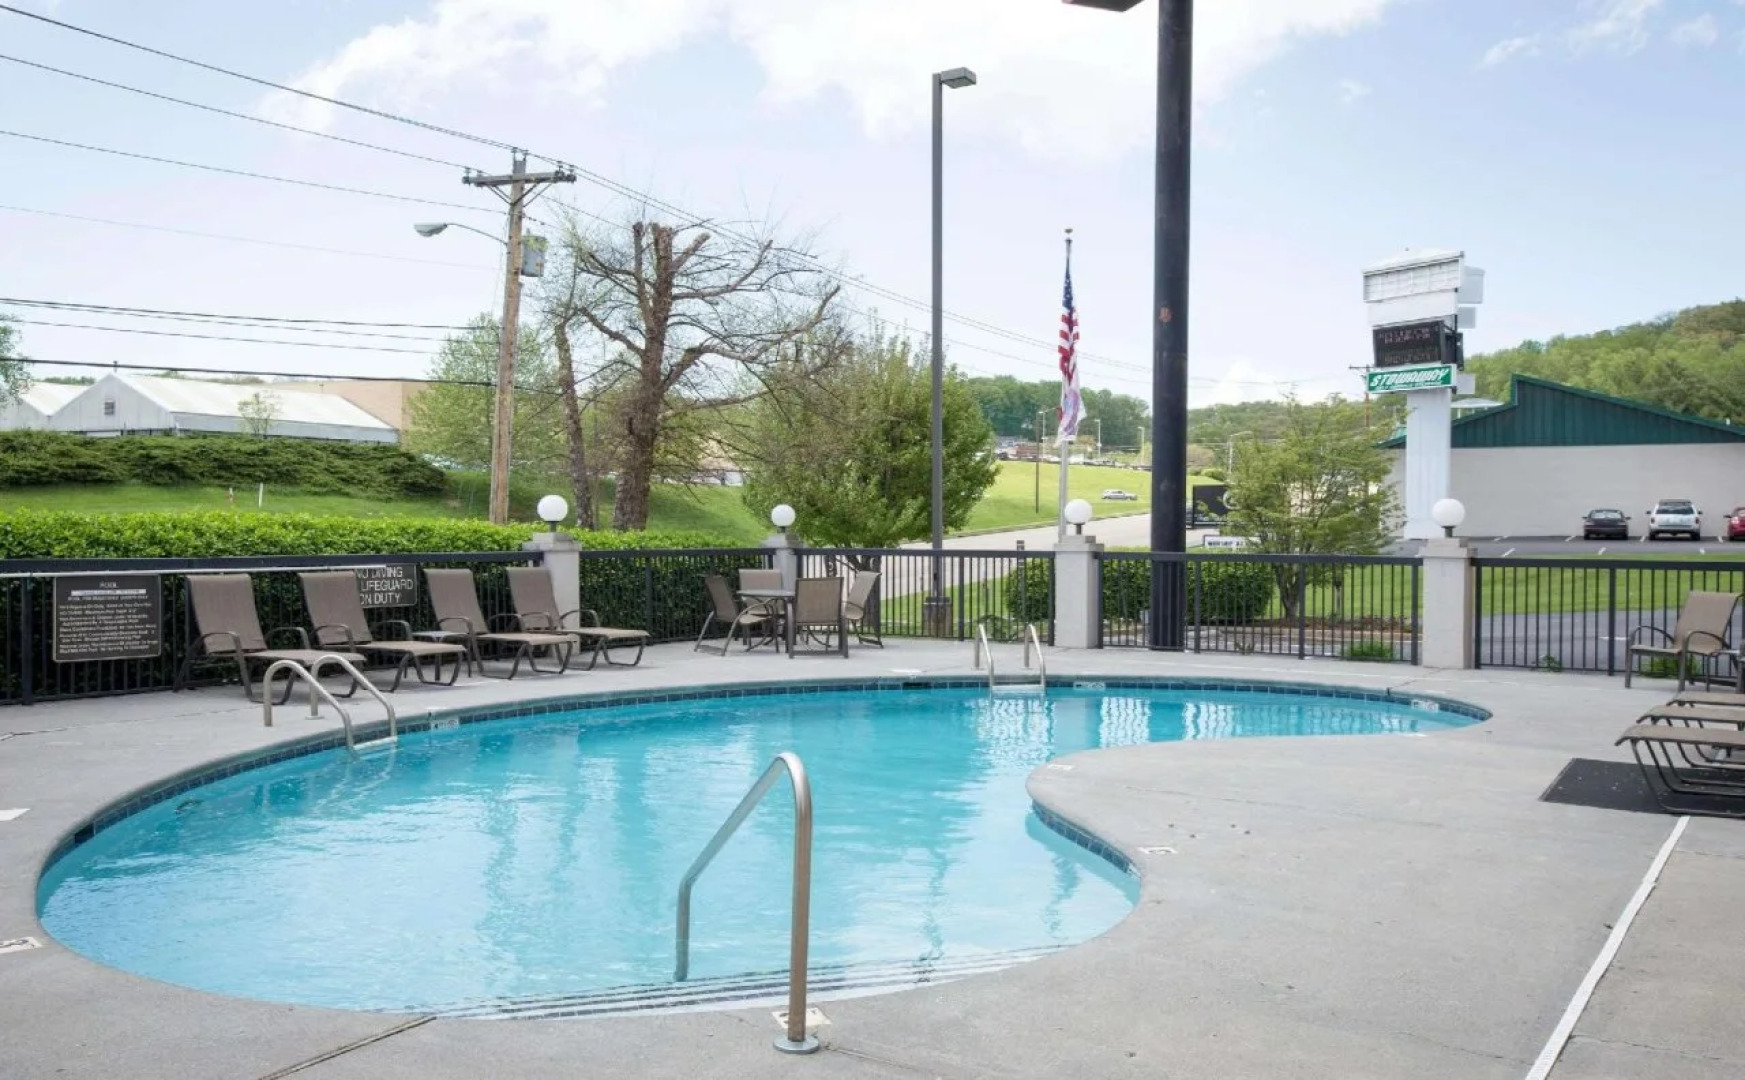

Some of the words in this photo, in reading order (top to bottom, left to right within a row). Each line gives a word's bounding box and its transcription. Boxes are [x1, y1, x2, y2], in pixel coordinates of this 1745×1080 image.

[371, 566, 403, 578] DIVING
[361, 579, 413, 591] LIFEGUARD
[374, 592, 400, 604] DUTY
